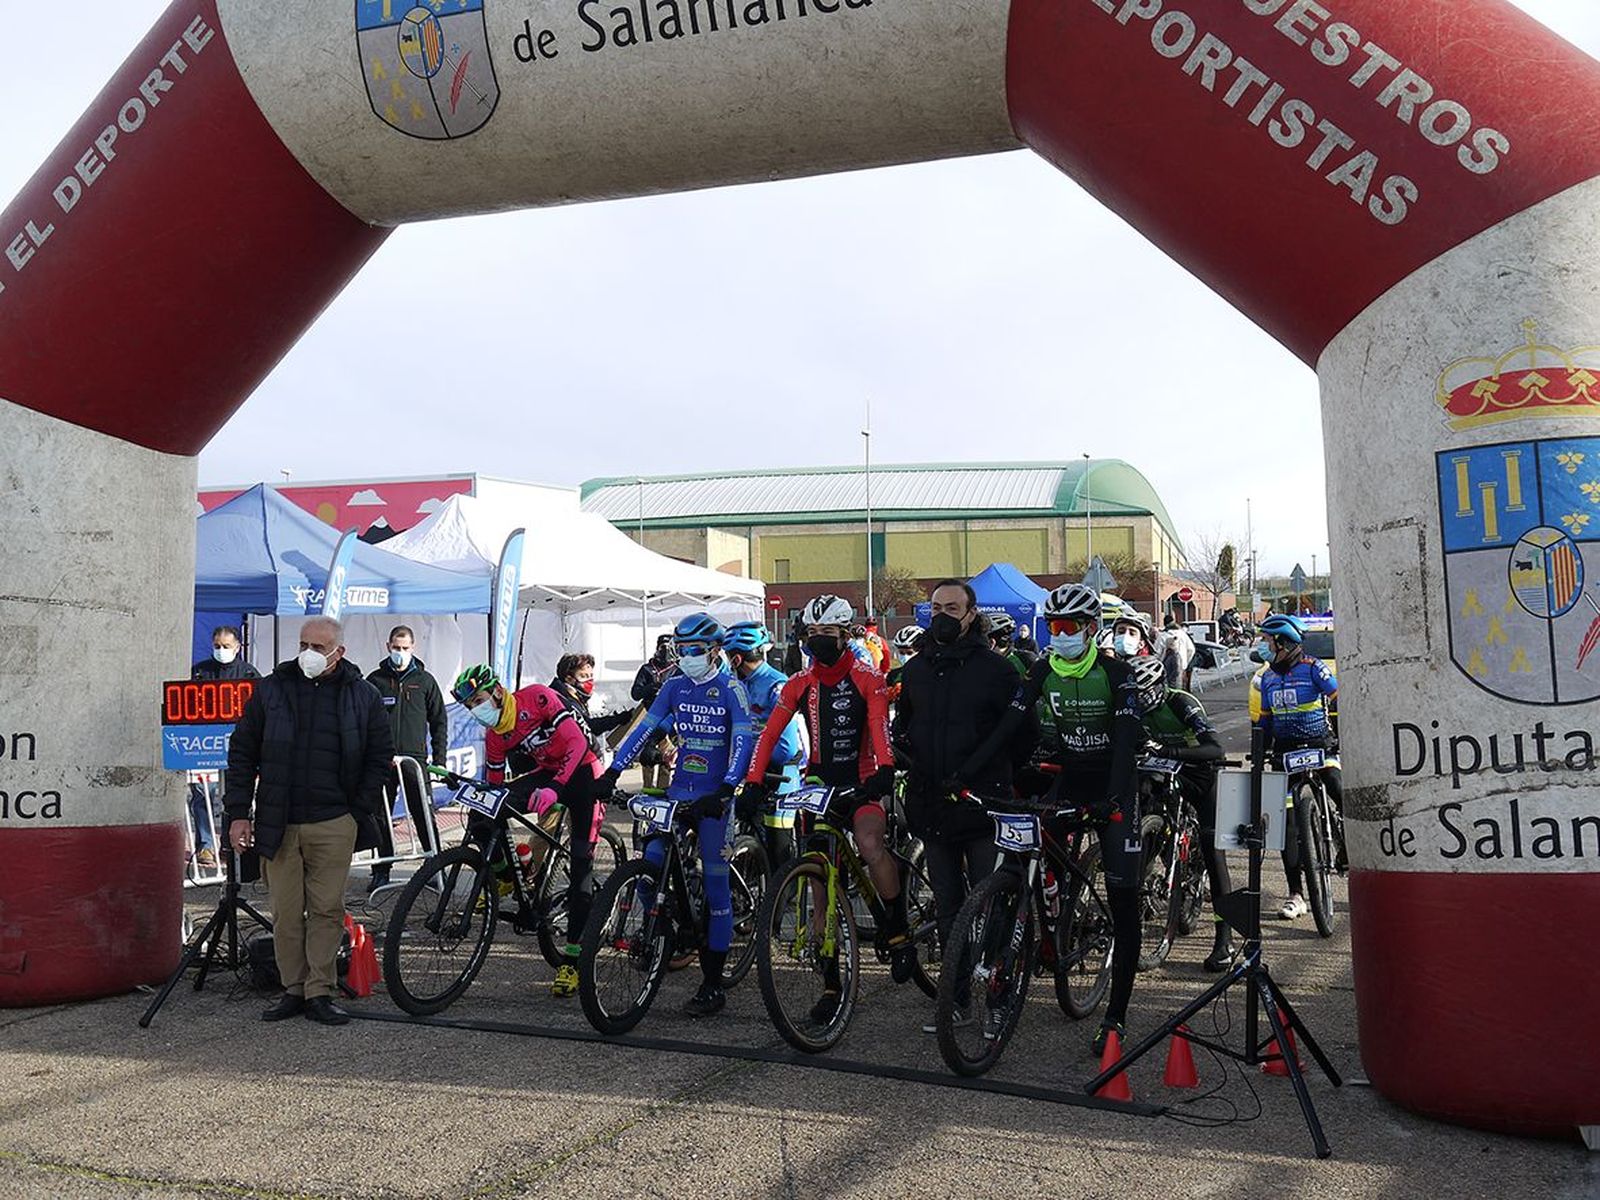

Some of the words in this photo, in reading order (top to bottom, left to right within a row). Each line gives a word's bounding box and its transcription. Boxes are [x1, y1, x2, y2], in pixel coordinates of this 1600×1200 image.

[513, 20, 559, 63] de
[577, 0, 873, 52] Salaman
[4, 219, 56, 272] EL
[52, 15, 215, 214] DEPORTE
[679, 703, 726, 716] CIUDAD
[692, 714, 711, 724] DE
[679, 724, 726, 734] OVIEDO
[470, 792, 487, 804] 51
[640, 806, 658, 821] 50
[1006, 826, 1023, 842] 53
[1379, 818, 1417, 857] de
